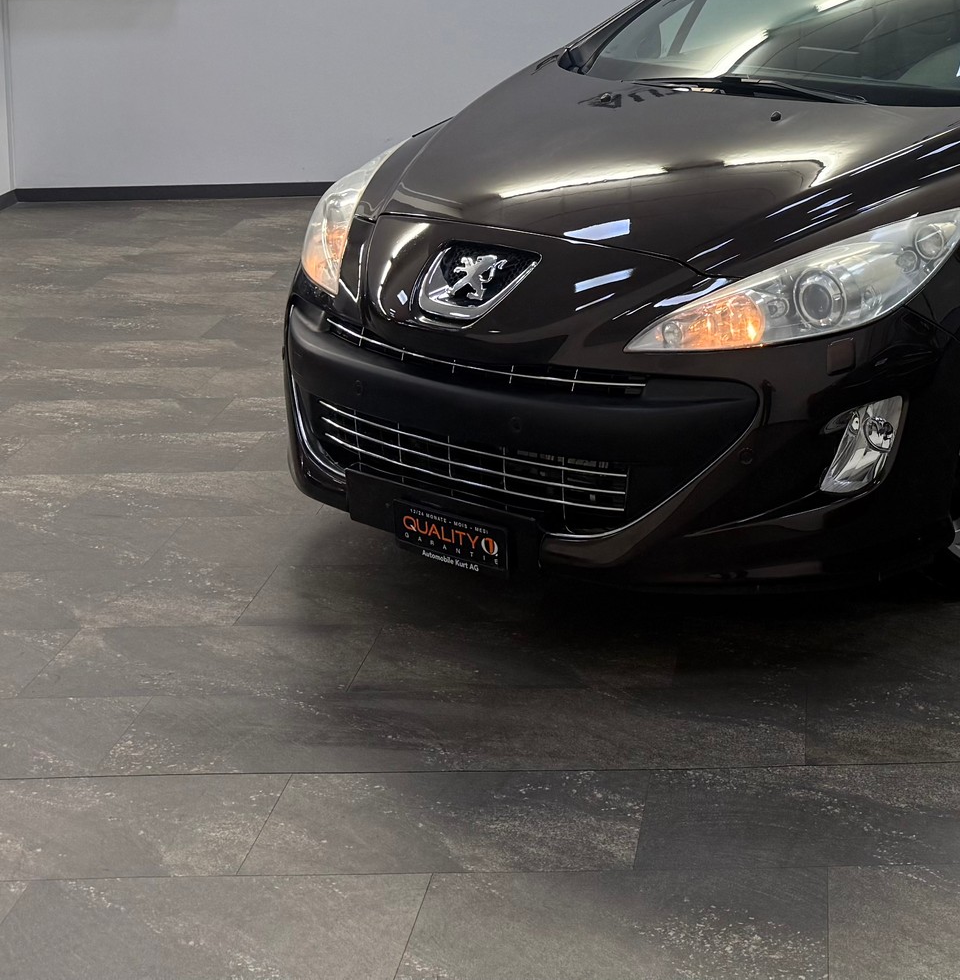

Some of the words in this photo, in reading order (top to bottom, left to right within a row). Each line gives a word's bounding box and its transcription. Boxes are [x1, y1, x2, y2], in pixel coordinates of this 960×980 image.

[426, 513, 447, 524] MONATE
[421, 549, 454, 565] Automobile
[455, 559, 469, 569] Kurt
[469, 564, 480, 572] AG
